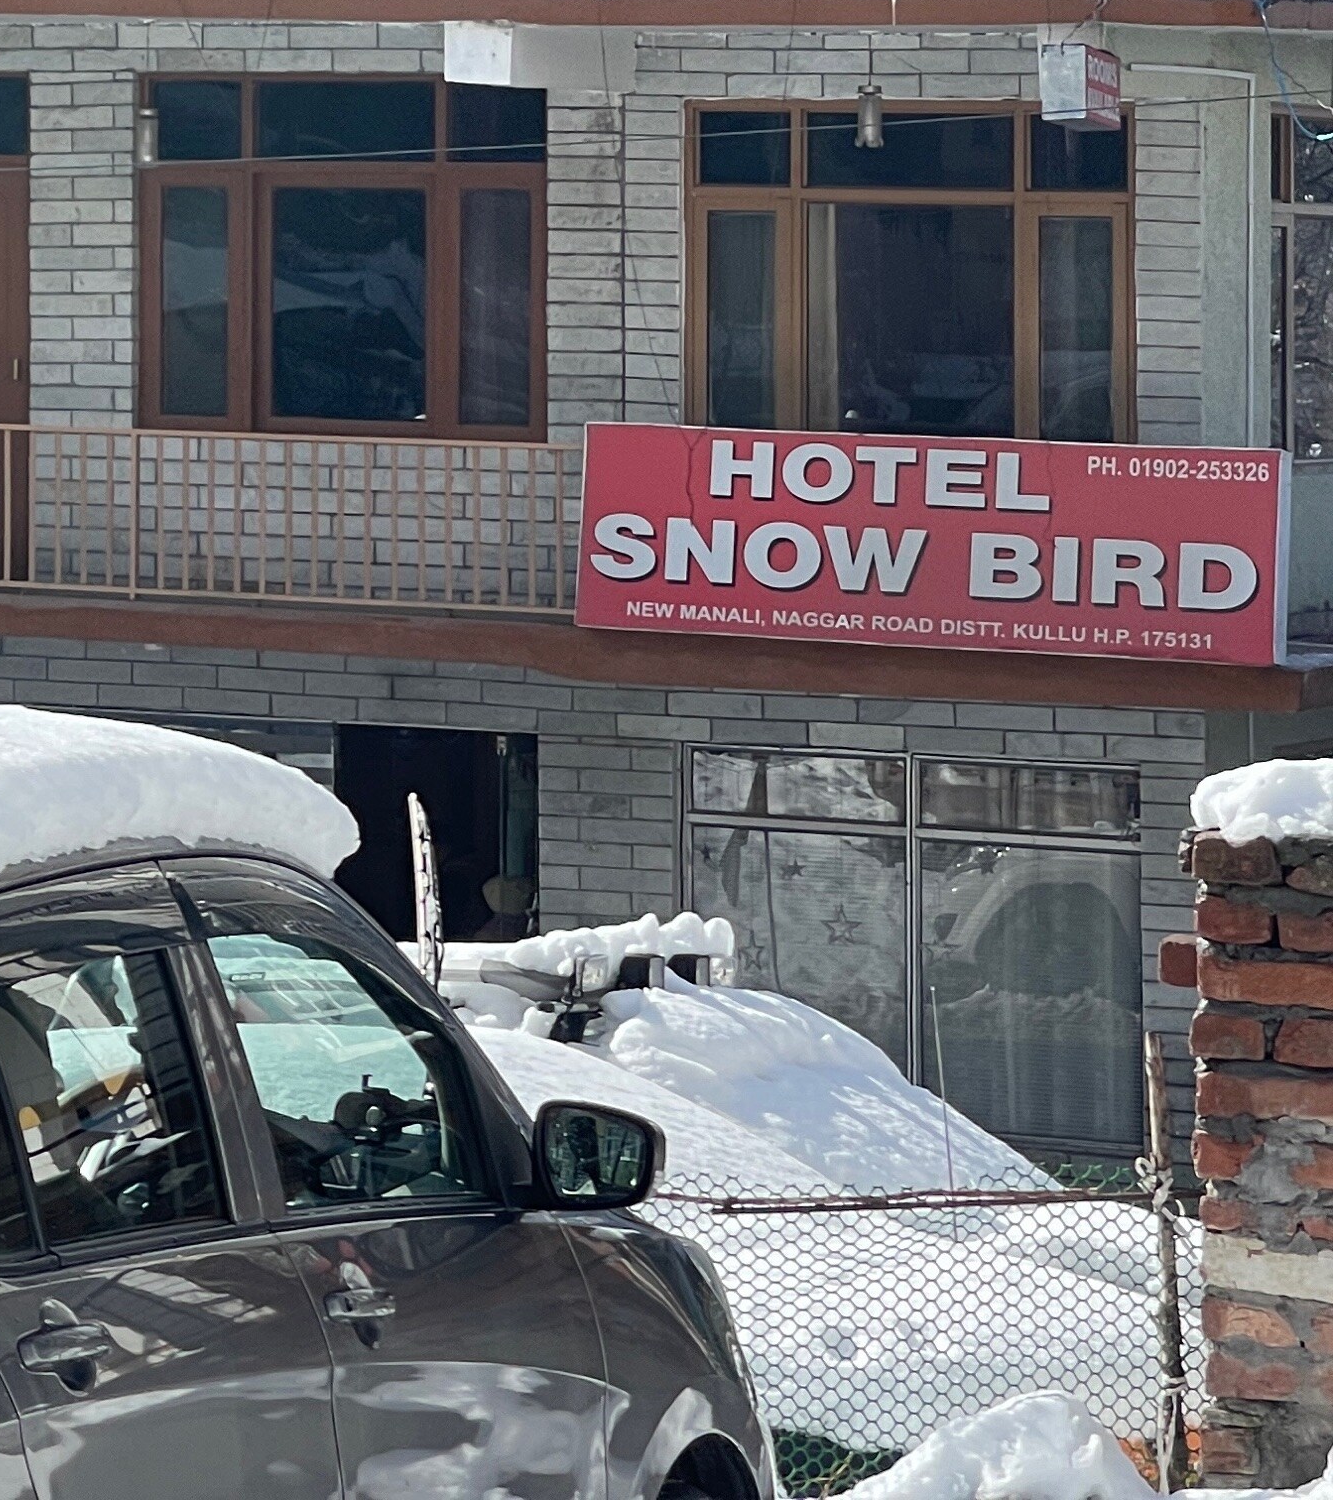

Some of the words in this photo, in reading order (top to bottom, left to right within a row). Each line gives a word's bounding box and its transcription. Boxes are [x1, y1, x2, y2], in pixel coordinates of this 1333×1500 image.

[709, 439, 1050, 511] HOTEL
[1087, 455, 1121, 476] PH.
[1129, 457, 1270, 482] 01902-253326
[590, 513, 928, 593] SNOW
[969, 532, 1258, 610] BIRD
[626, 601, 674, 618] NEW
[679, 604, 765, 627] MANALI,
[772, 610, 864, 630] NAGGAR
[871, 615, 933, 633] ROAD
[940, 619, 1005, 638] DISTT.
[1013, 623, 1086, 642] KULLU
[1093, 628, 1132, 645] H.P.
[1140, 631, 1213, 650] 175131
